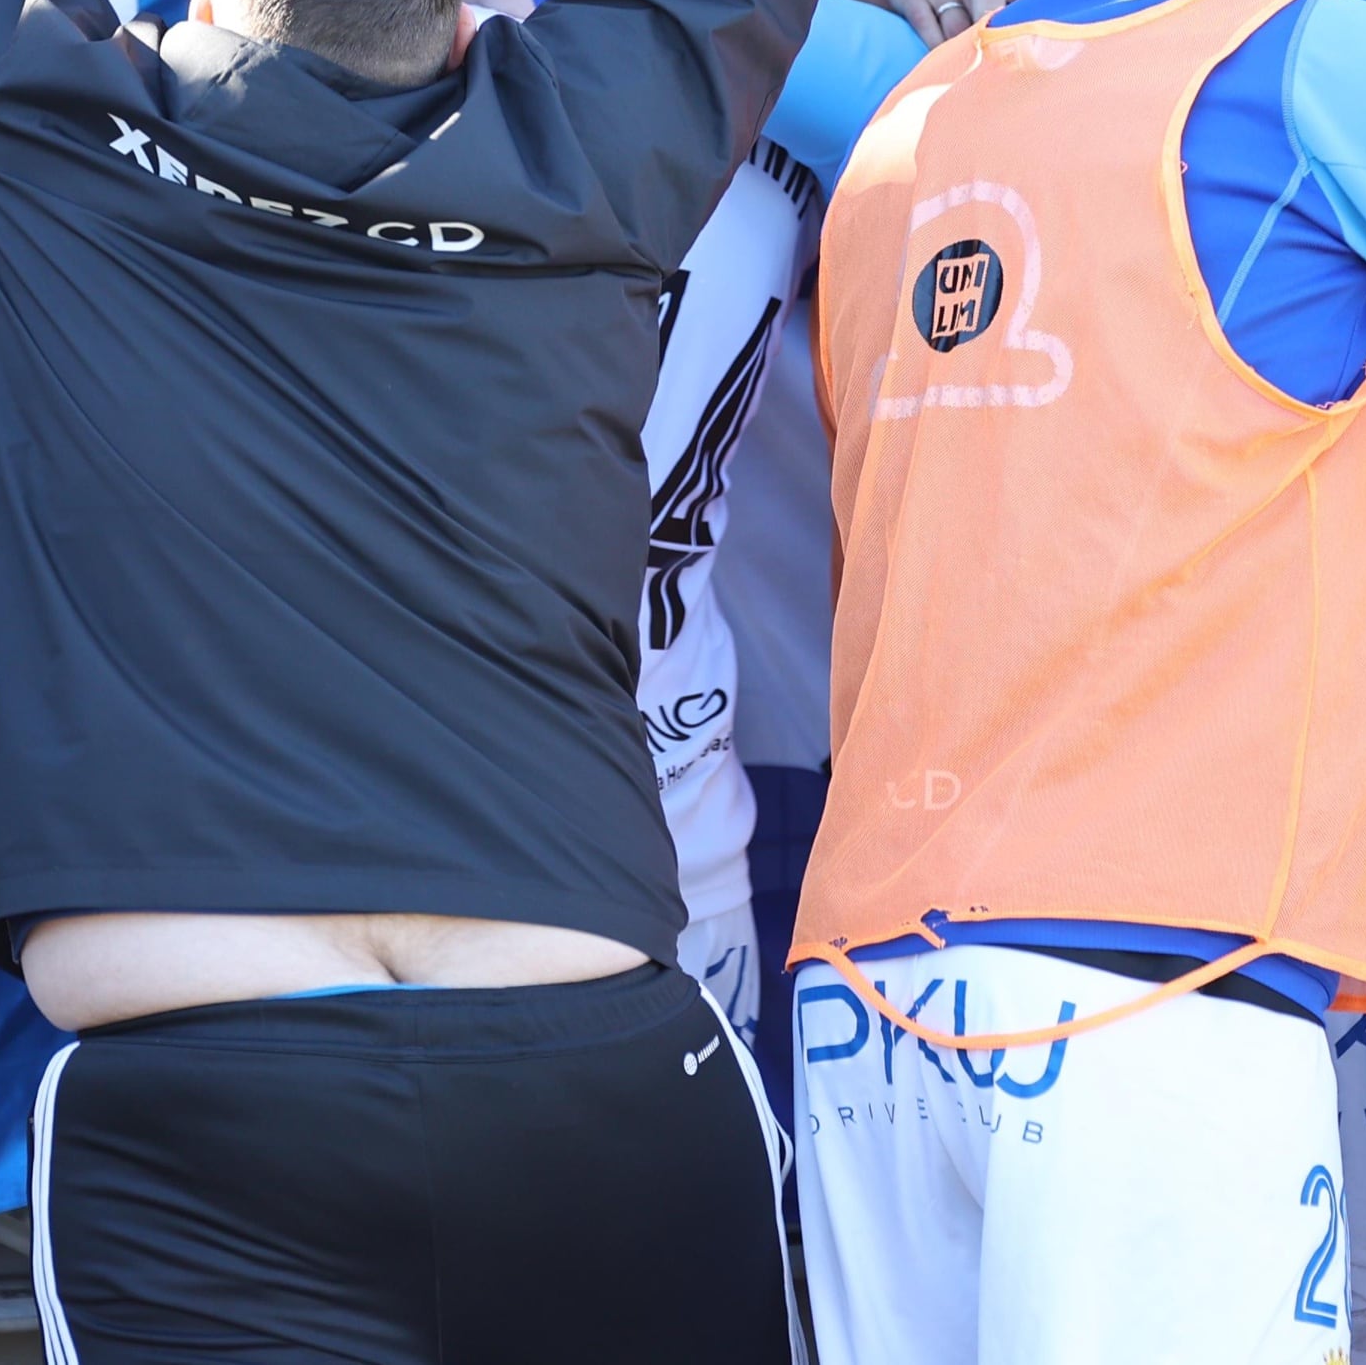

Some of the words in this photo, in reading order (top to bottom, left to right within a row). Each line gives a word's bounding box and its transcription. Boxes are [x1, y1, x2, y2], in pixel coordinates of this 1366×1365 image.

[367, 221, 485, 253] CD
[939, 260, 985, 294] UNI
[936, 299, 975, 333] LIM
[1294, 1164, 1352, 1331] 2
